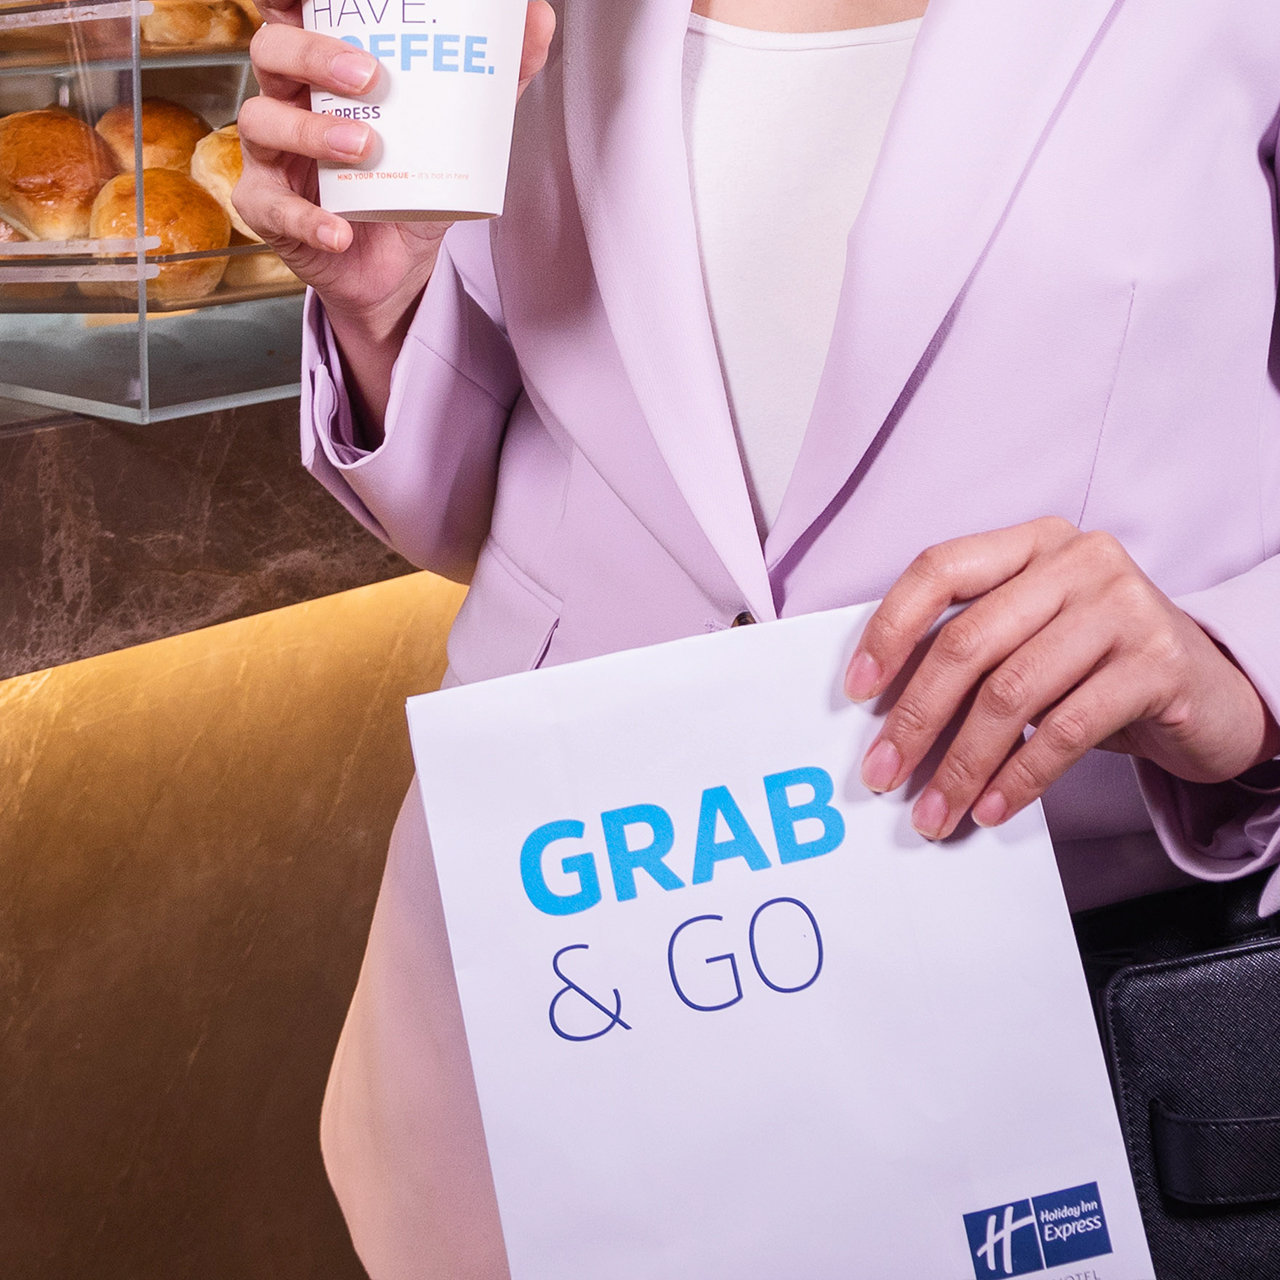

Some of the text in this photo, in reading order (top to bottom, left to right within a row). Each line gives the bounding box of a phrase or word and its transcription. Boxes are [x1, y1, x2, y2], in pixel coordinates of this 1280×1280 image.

[339, 33, 495, 75] FFEE.
[337, 173, 353, 181] MIND
[354, 172, 374, 181] YOUR
[376, 172, 409, 180] TONGUE
[520, 766, 846, 916] GRAB
[549, 897, 824, 1042] & GO
[1040, 1200, 1098, 1224] Holiday Inn
[1044, 1215, 1102, 1242] Express
